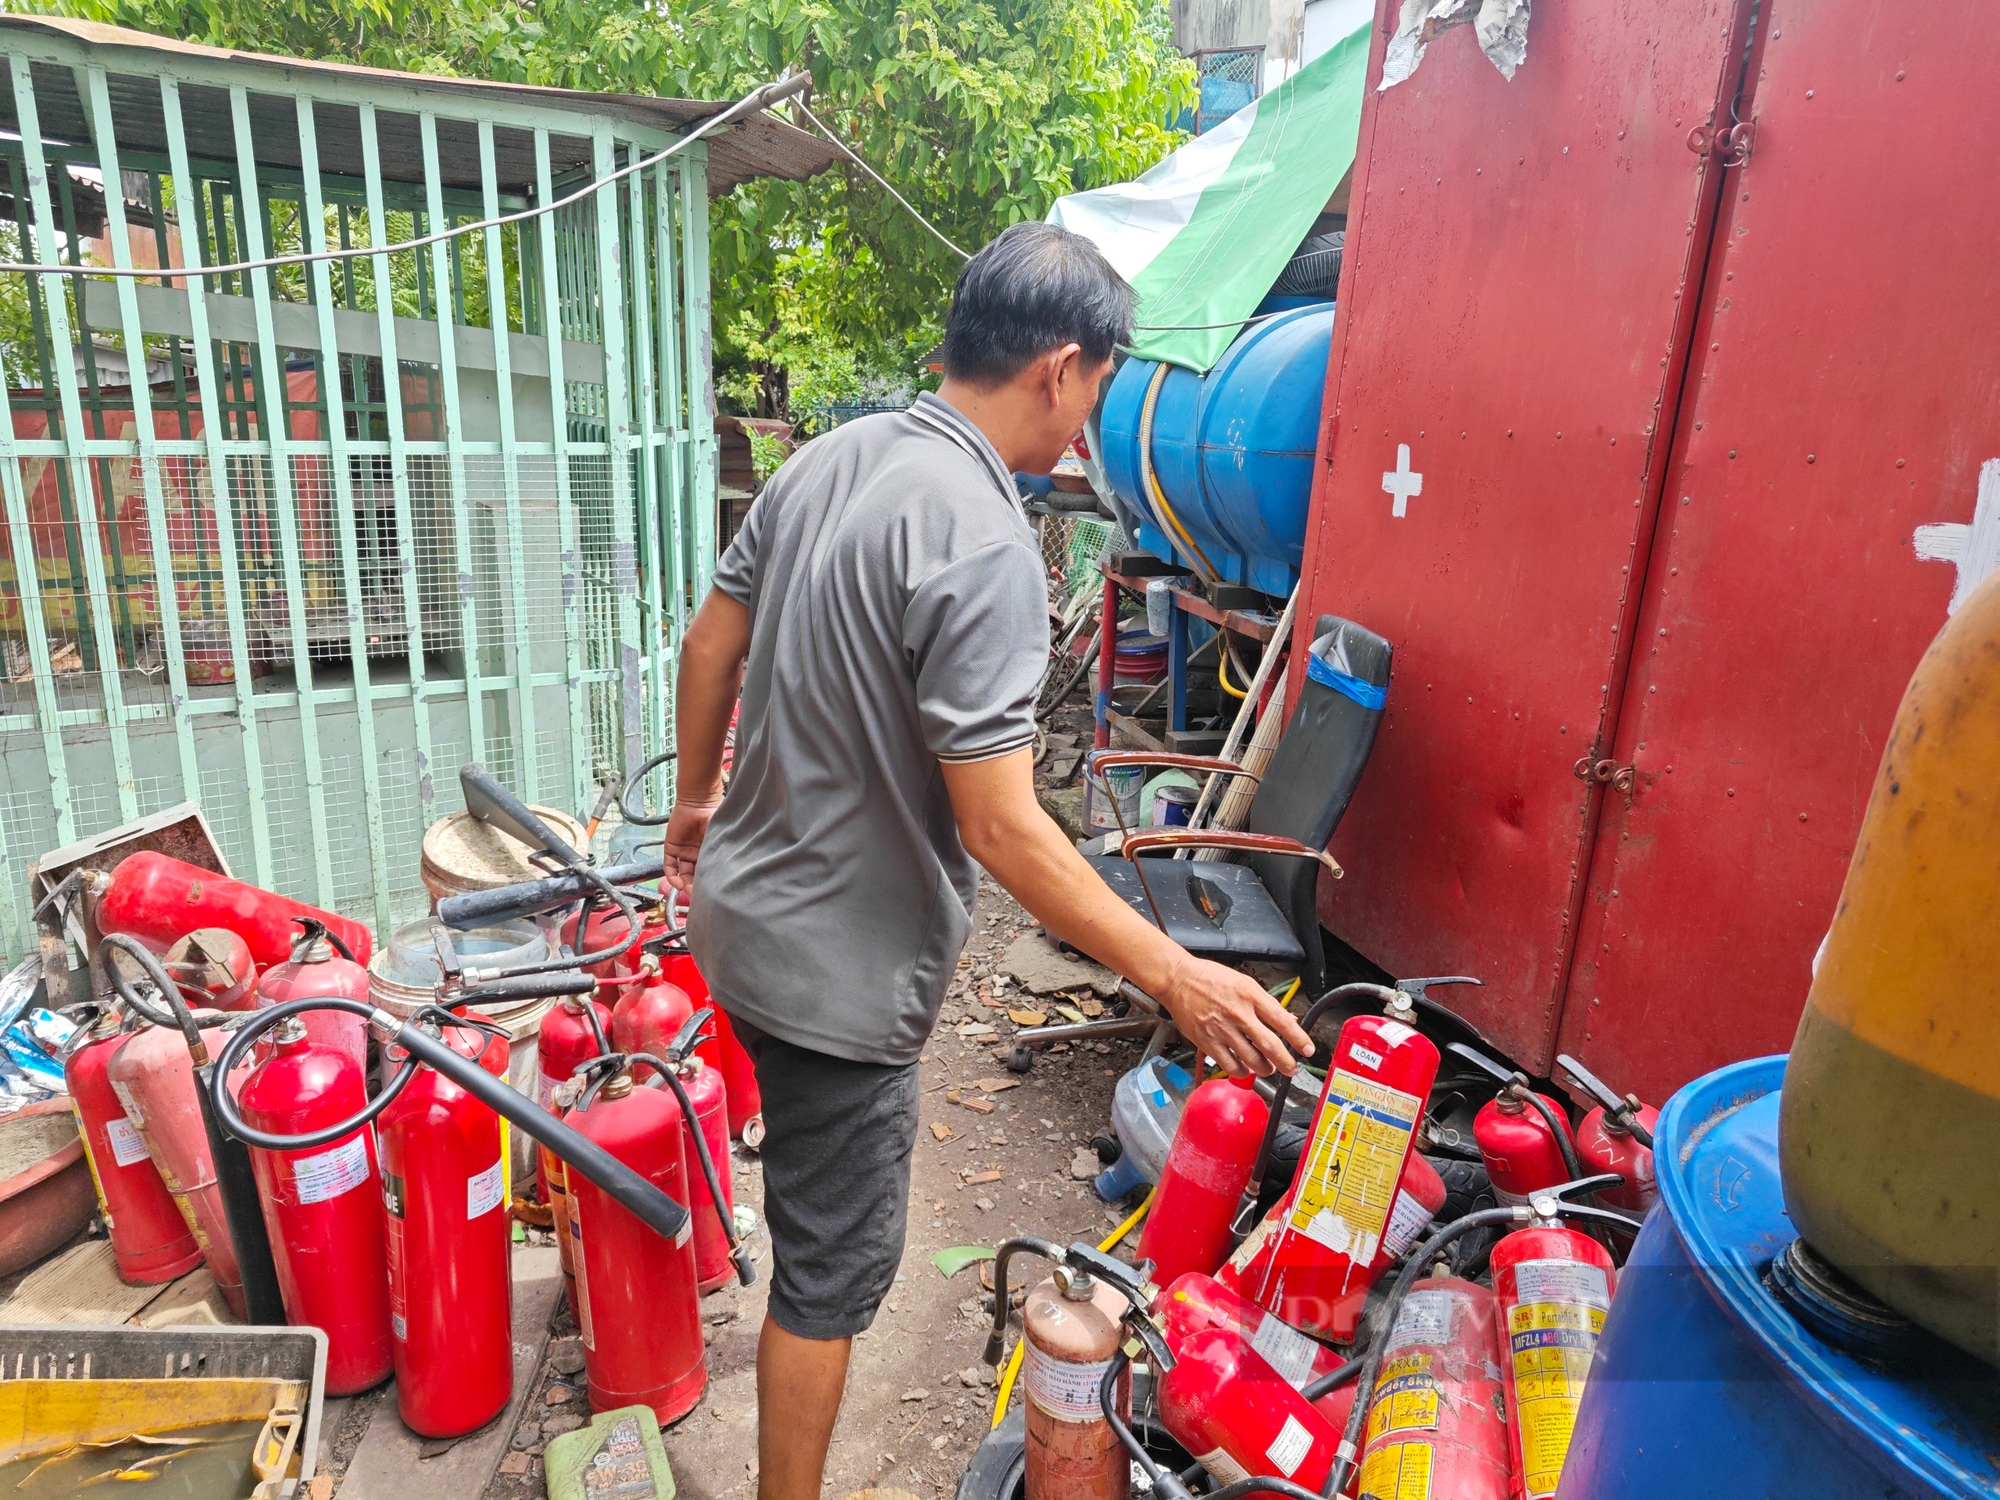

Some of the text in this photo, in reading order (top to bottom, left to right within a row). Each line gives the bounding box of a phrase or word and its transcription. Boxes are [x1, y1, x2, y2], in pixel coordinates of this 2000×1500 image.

[1355, 1048, 1377, 1064] LOAN
[1353, 1082, 1396, 1105] YONGJIN
[1541, 1310, 1573, 1324] Portable
[1514, 1331, 1578, 1350] MFZL4 ABC Dry
[1063, 1378, 1081, 1386] HÀNH
[1407, 1377, 1433, 1388] 8kg
[611, 1441, 641, 1454] MOLY
